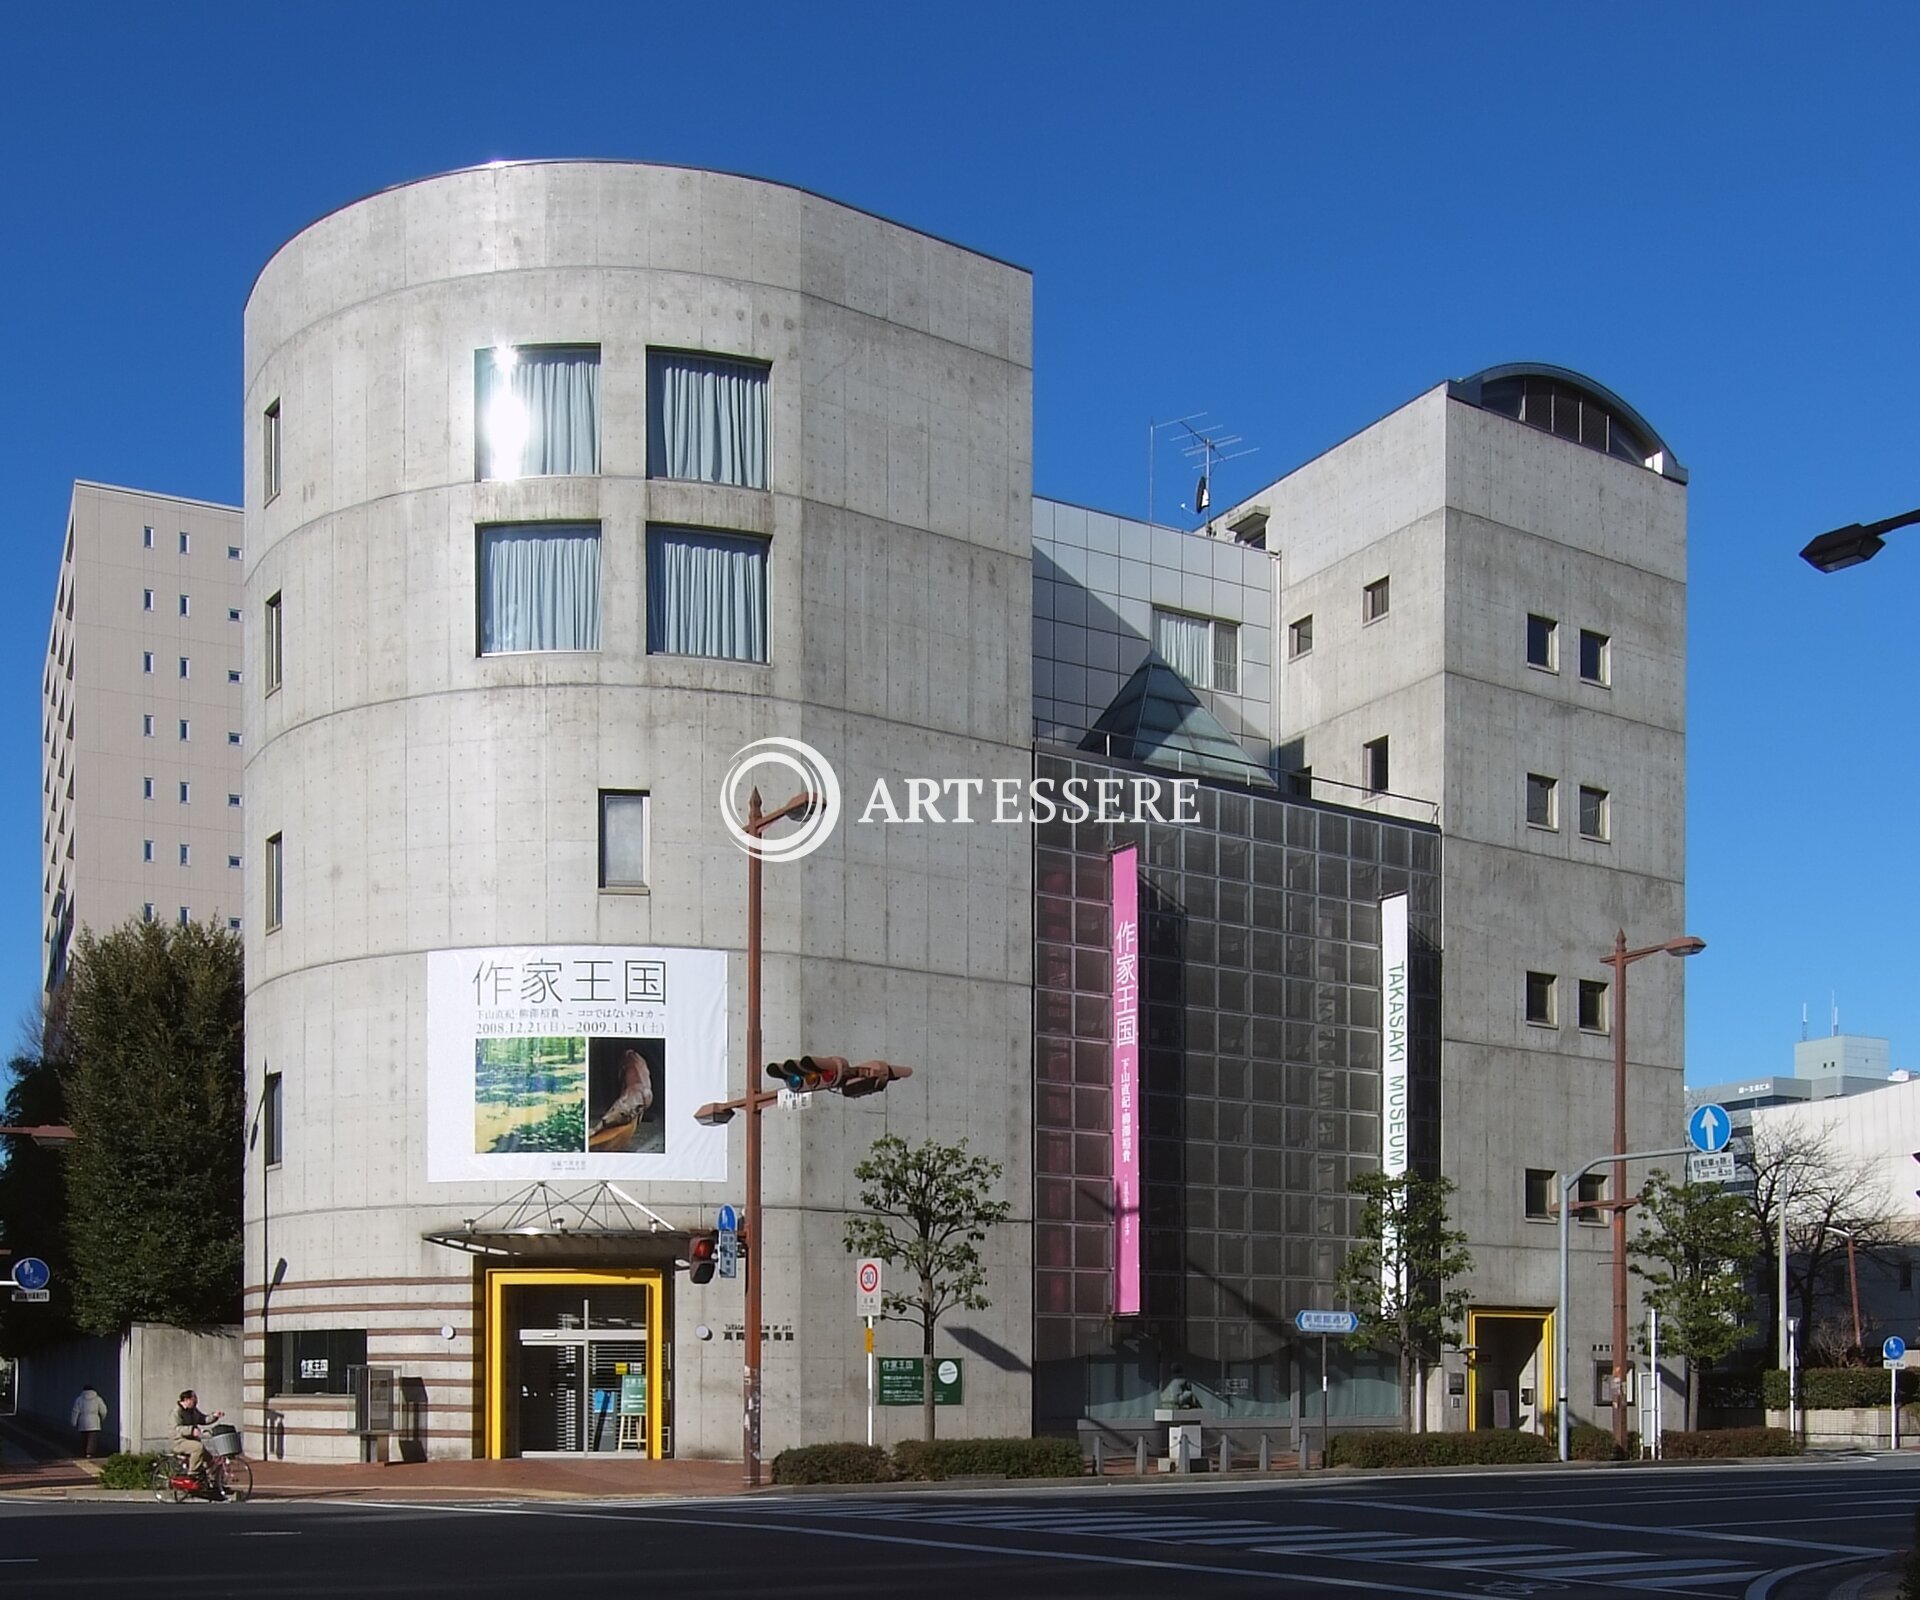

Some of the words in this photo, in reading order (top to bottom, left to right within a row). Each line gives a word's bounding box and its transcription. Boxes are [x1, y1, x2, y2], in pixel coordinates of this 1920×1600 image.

[472, 958, 666, 1006] 作家王国
[1116, 920, 1136, 1048] 作家王国
[1389, 961, 1404, 1062] TAKASAKI
[1389, 1075, 1404, 1166] MUSEUM
